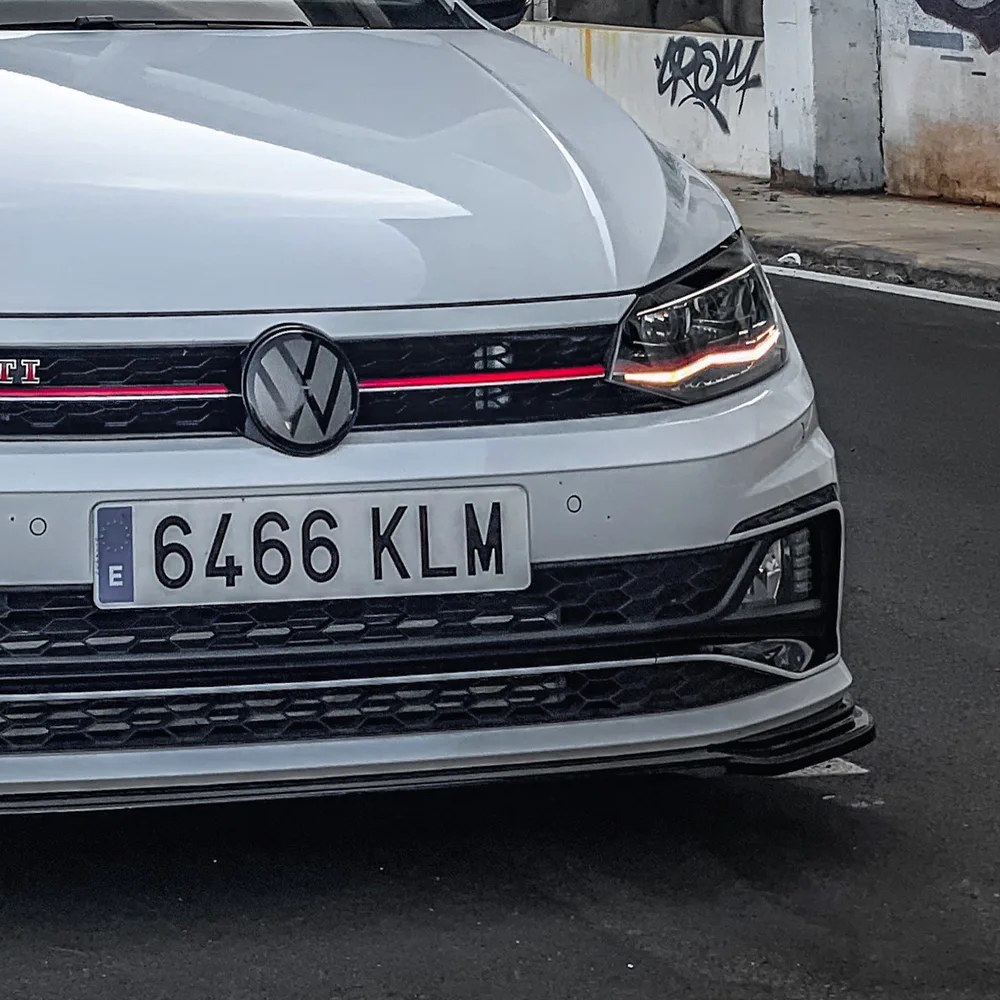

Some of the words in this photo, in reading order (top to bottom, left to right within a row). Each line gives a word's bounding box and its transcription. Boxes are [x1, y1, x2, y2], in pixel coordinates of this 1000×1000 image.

[153, 508, 340, 589] 6466
[371, 501, 505, 581] KLM
[109, 565, 123, 586] E
